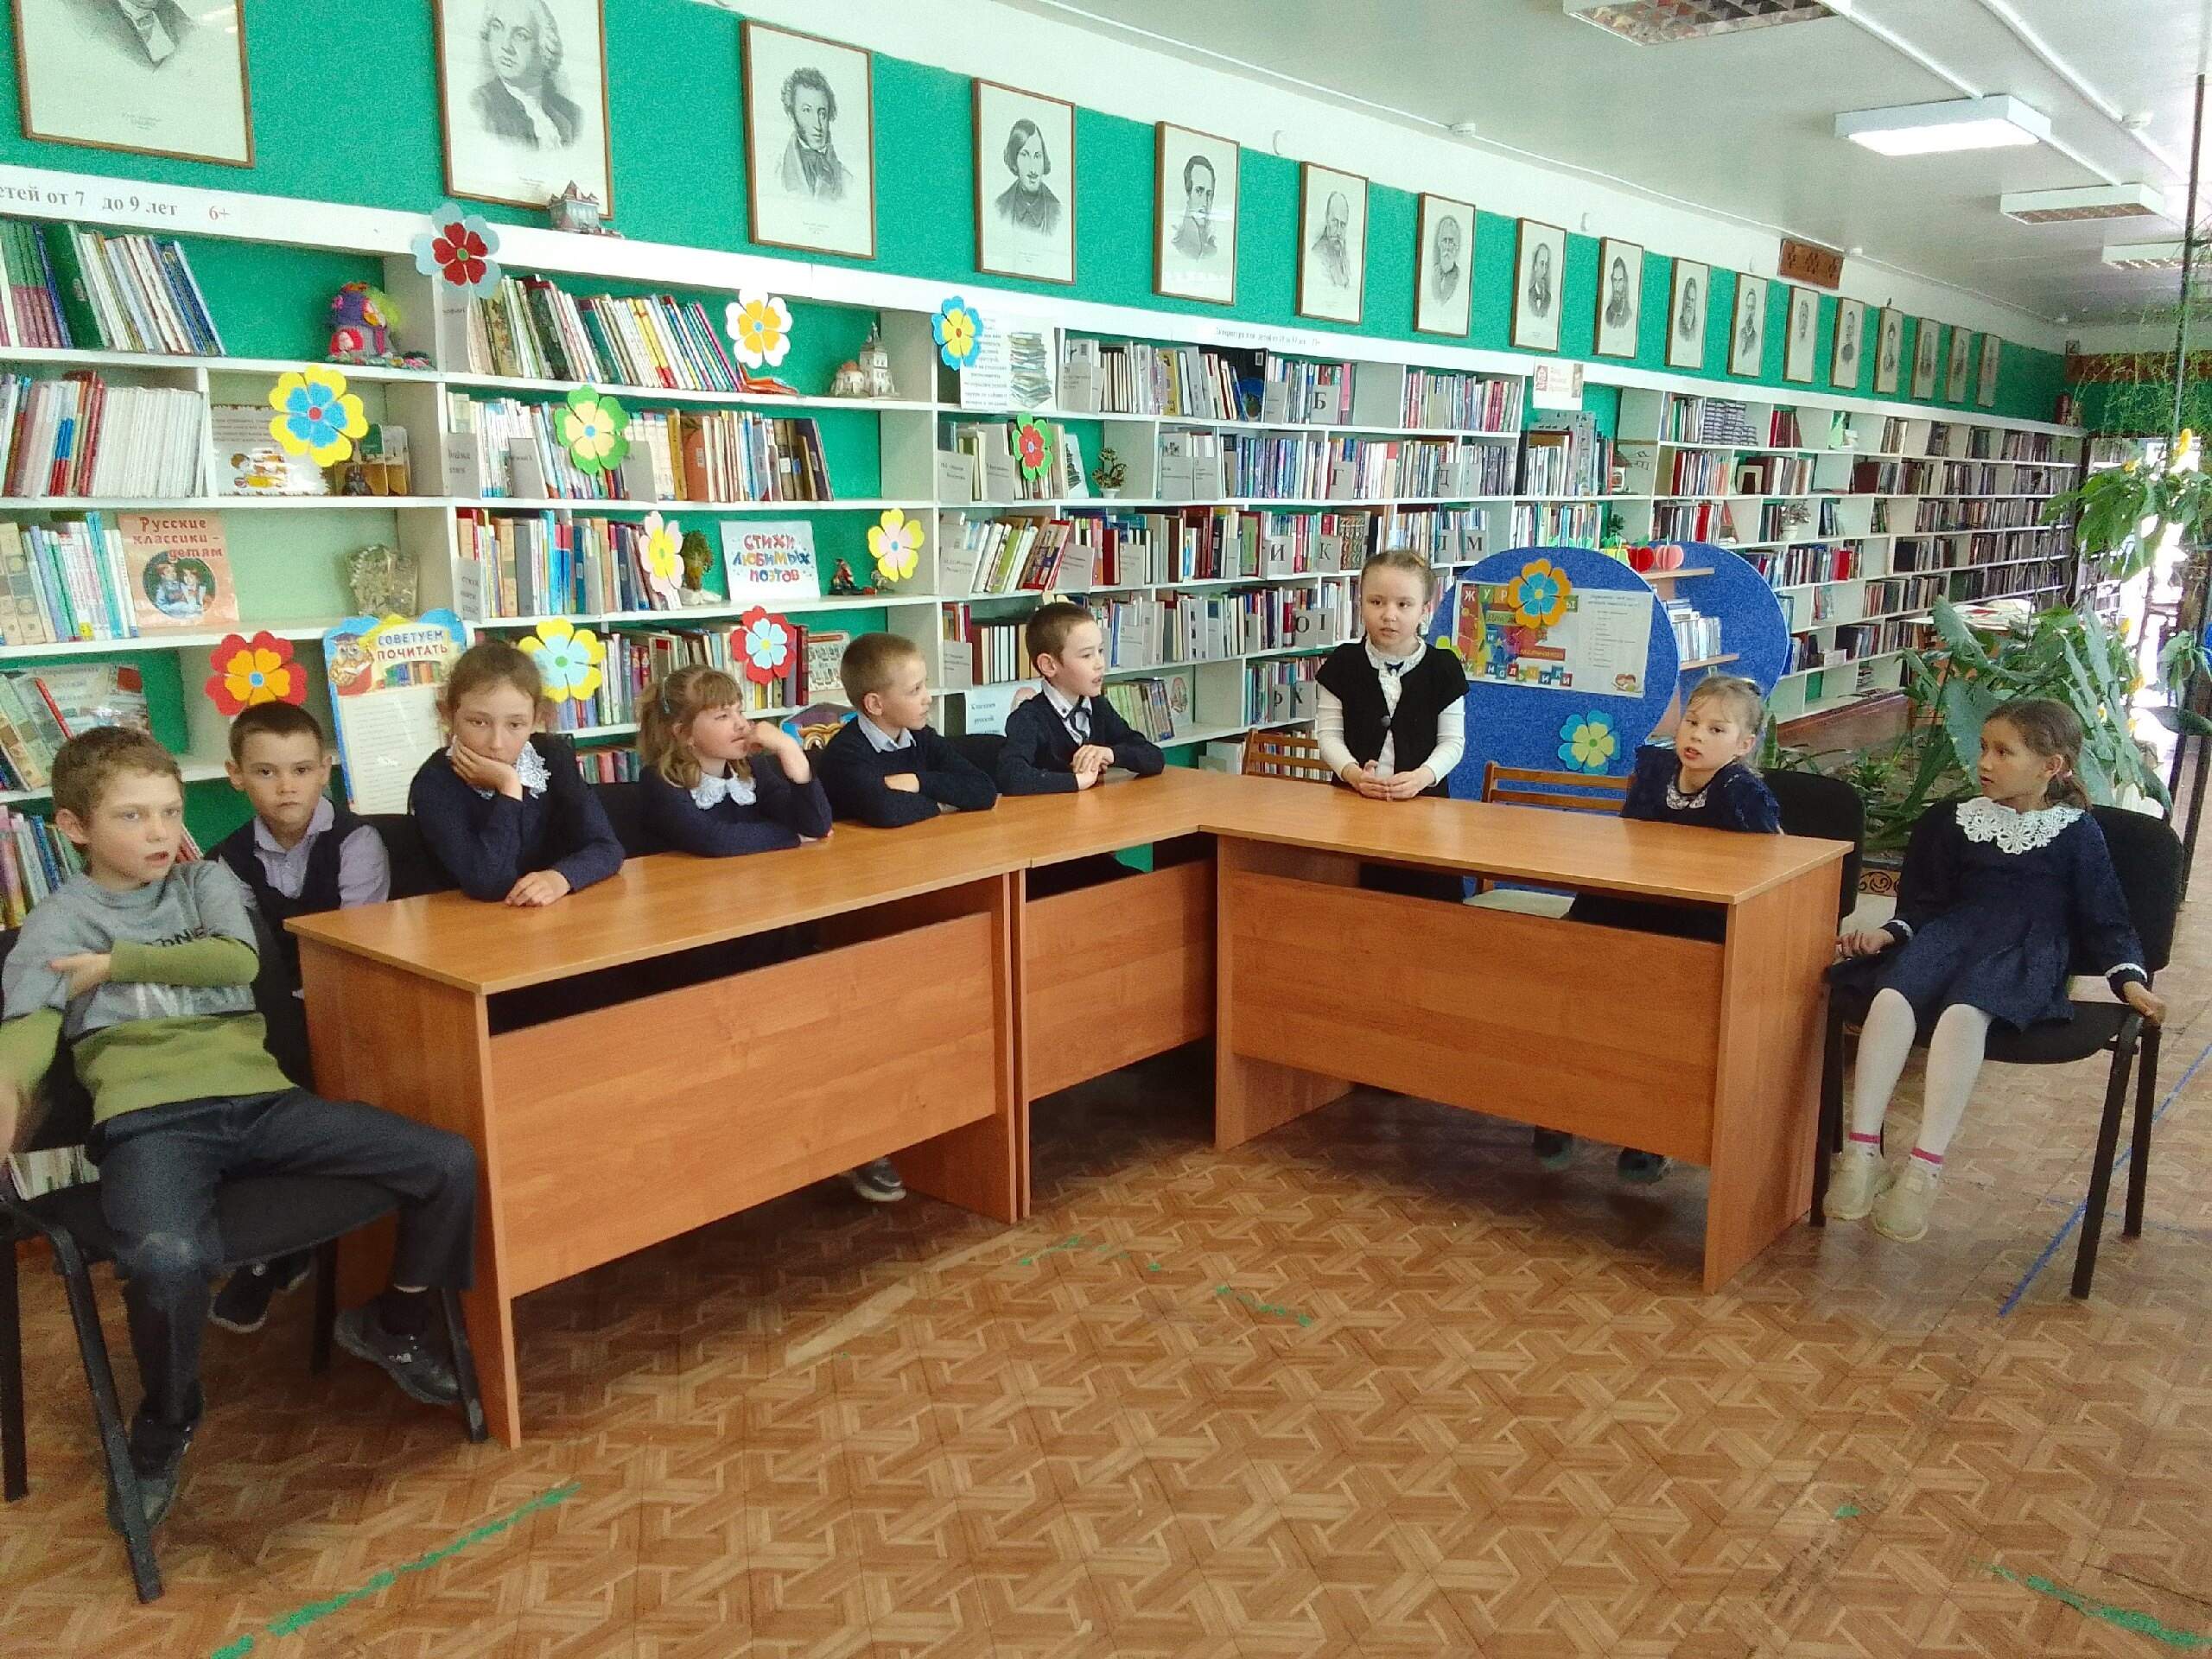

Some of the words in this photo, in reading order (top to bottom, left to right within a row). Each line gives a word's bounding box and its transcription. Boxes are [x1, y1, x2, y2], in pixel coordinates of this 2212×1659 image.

[48, 192, 68, 206] от
[75, 190, 85, 207] 7
[102, 196, 124, 211] до
[130, 195, 139, 212] 9
[145, 201, 178, 215] лет
[208, 205, 230, 221] 6+
[139, 516, 207, 533] Русские
[132, 534, 208, 545] классики
[744, 533, 795, 550] СТИХИ
[1466, 536, 1483, 551] М
[168, 548, 222, 561] детям
[733, 550, 810, 567] ЛЮБИМЫХ
[1270, 543, 1285, 562] И
[1319, 542, 1332, 560] К
[749, 568, 800, 582] ПОЭТОВ
[378, 630, 443, 645] СОВЕТУЕМ
[377, 644, 448, 661] ПОЧИТАТЬ
